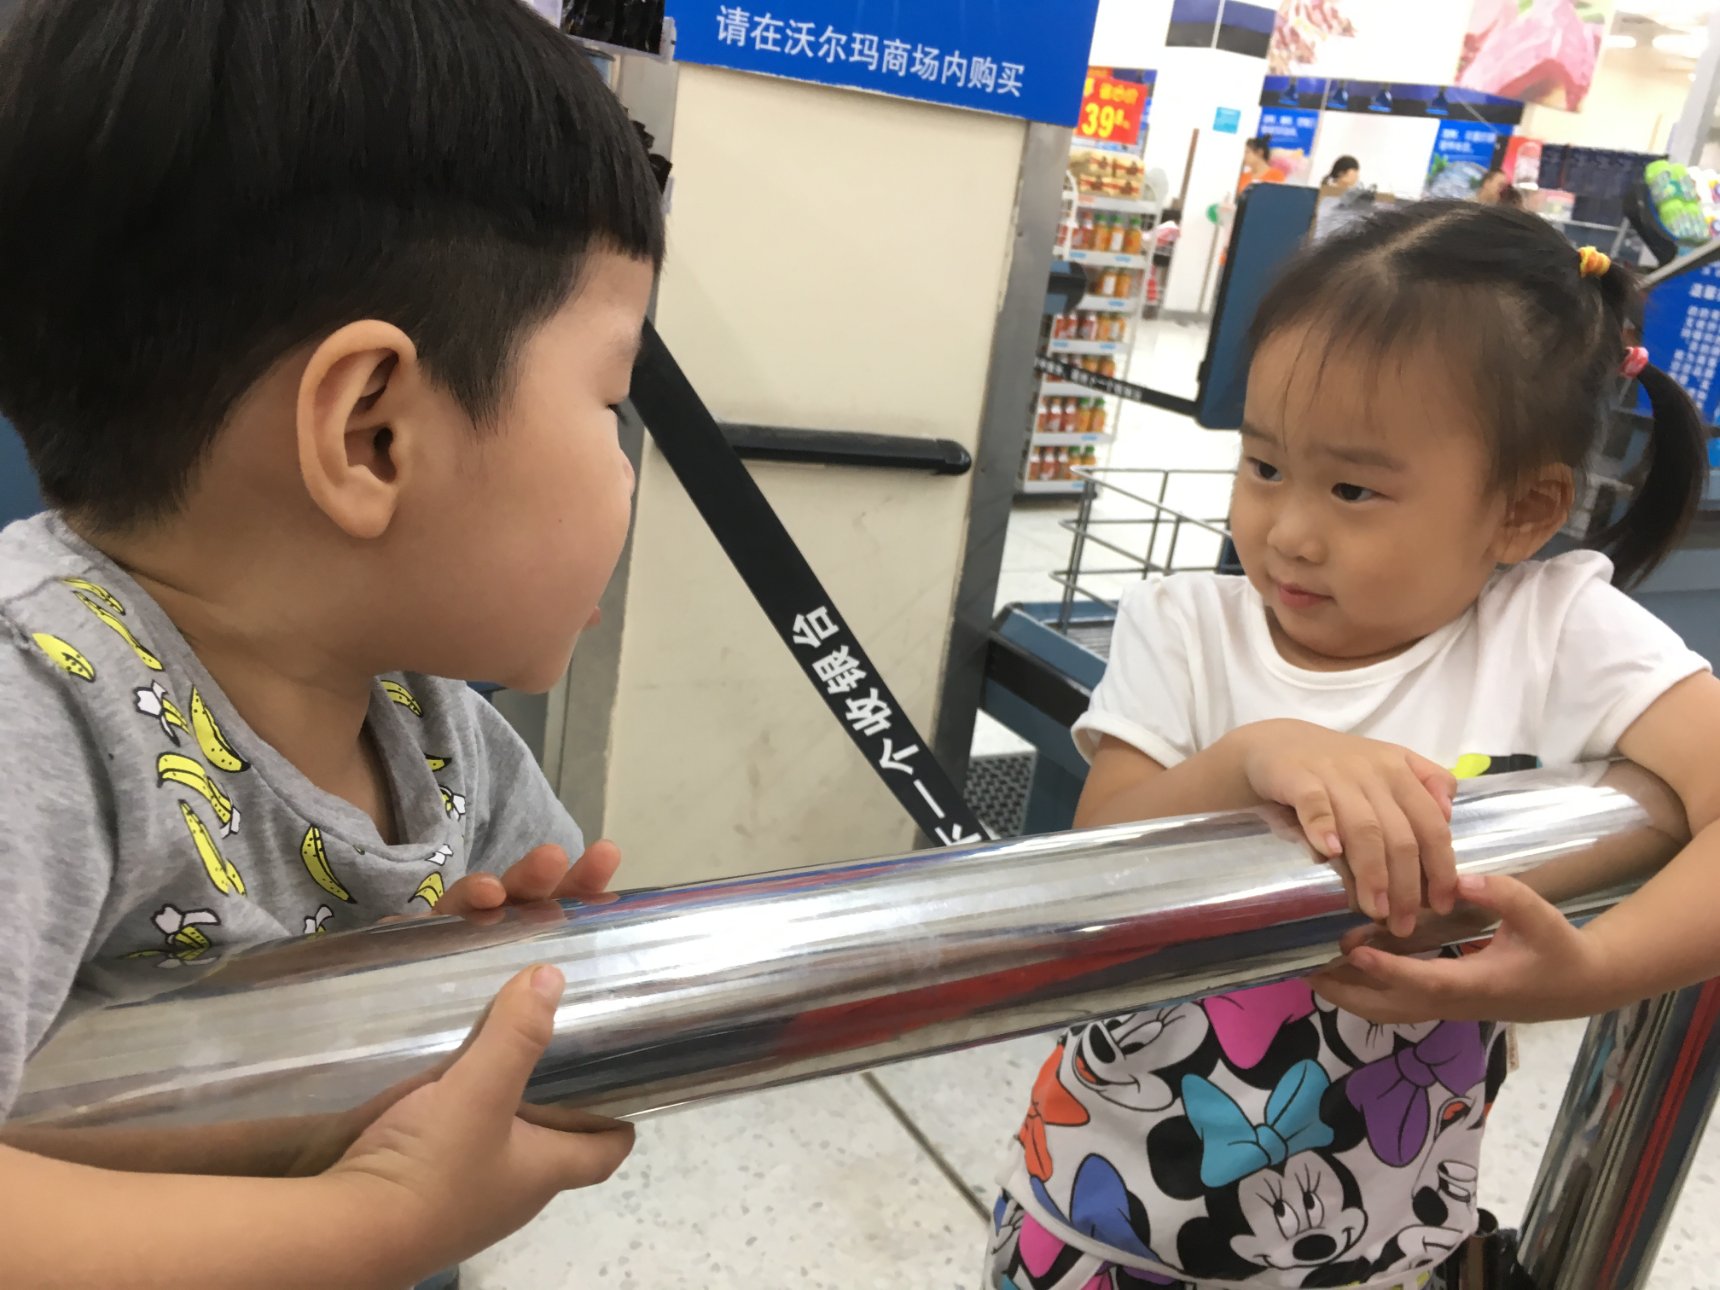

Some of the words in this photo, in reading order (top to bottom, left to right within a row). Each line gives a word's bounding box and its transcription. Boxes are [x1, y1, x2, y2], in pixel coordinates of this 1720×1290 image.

[716, 5, 1025, 97] 请在沃尔玛商场内购买
[792, 605, 982, 846] 下一个收银台
